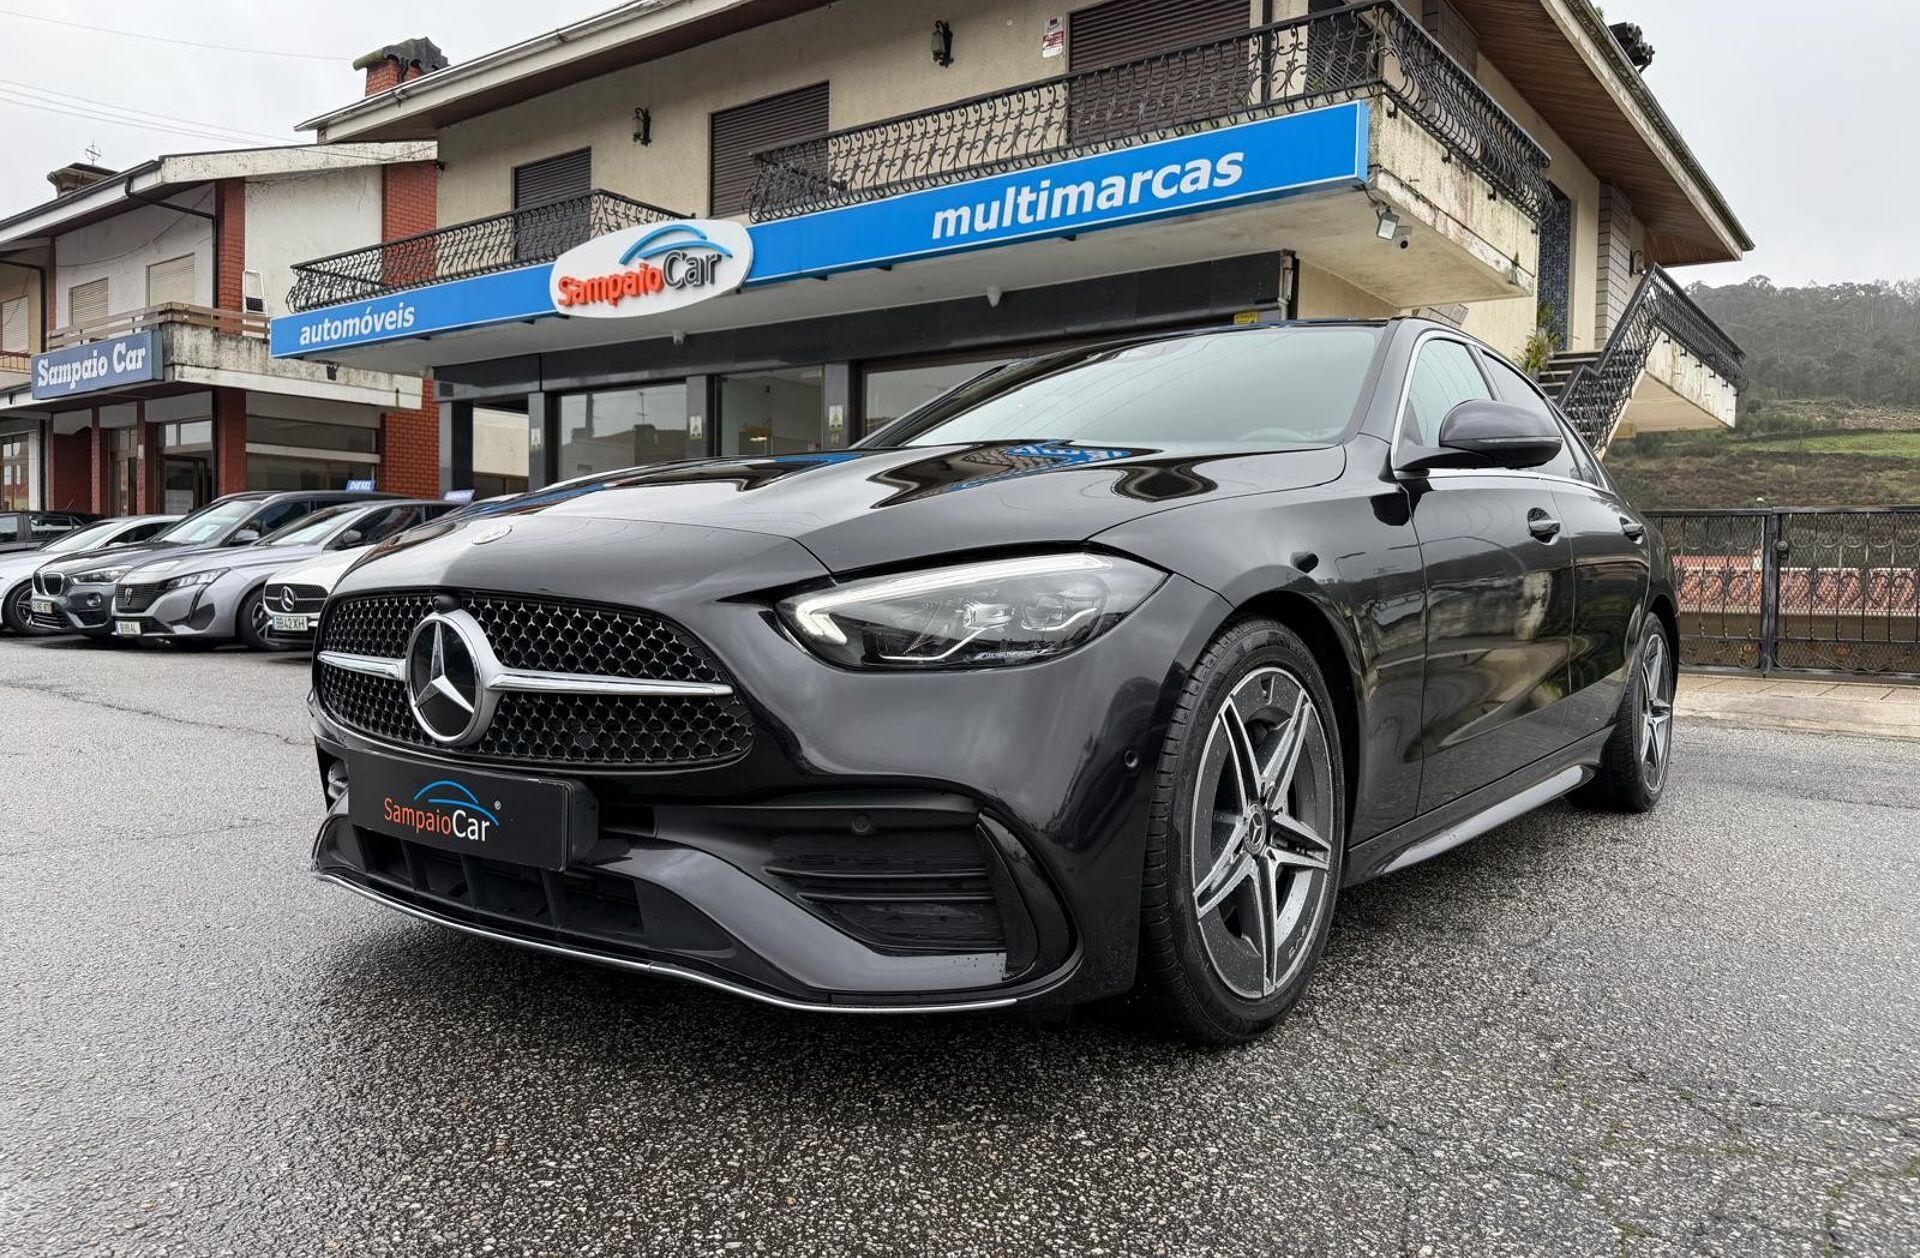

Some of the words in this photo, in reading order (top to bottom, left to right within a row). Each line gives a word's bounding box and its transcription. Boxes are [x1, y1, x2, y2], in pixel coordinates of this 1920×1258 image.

[931, 151, 1245, 240] multimarcas
[557, 251, 722, 308] SampaioCar
[299, 303, 415, 345] automóveis
[37, 355, 108, 390] Sampaio
[112, 342, 146, 374] Car
[384, 796, 491, 842] SampaioCar
